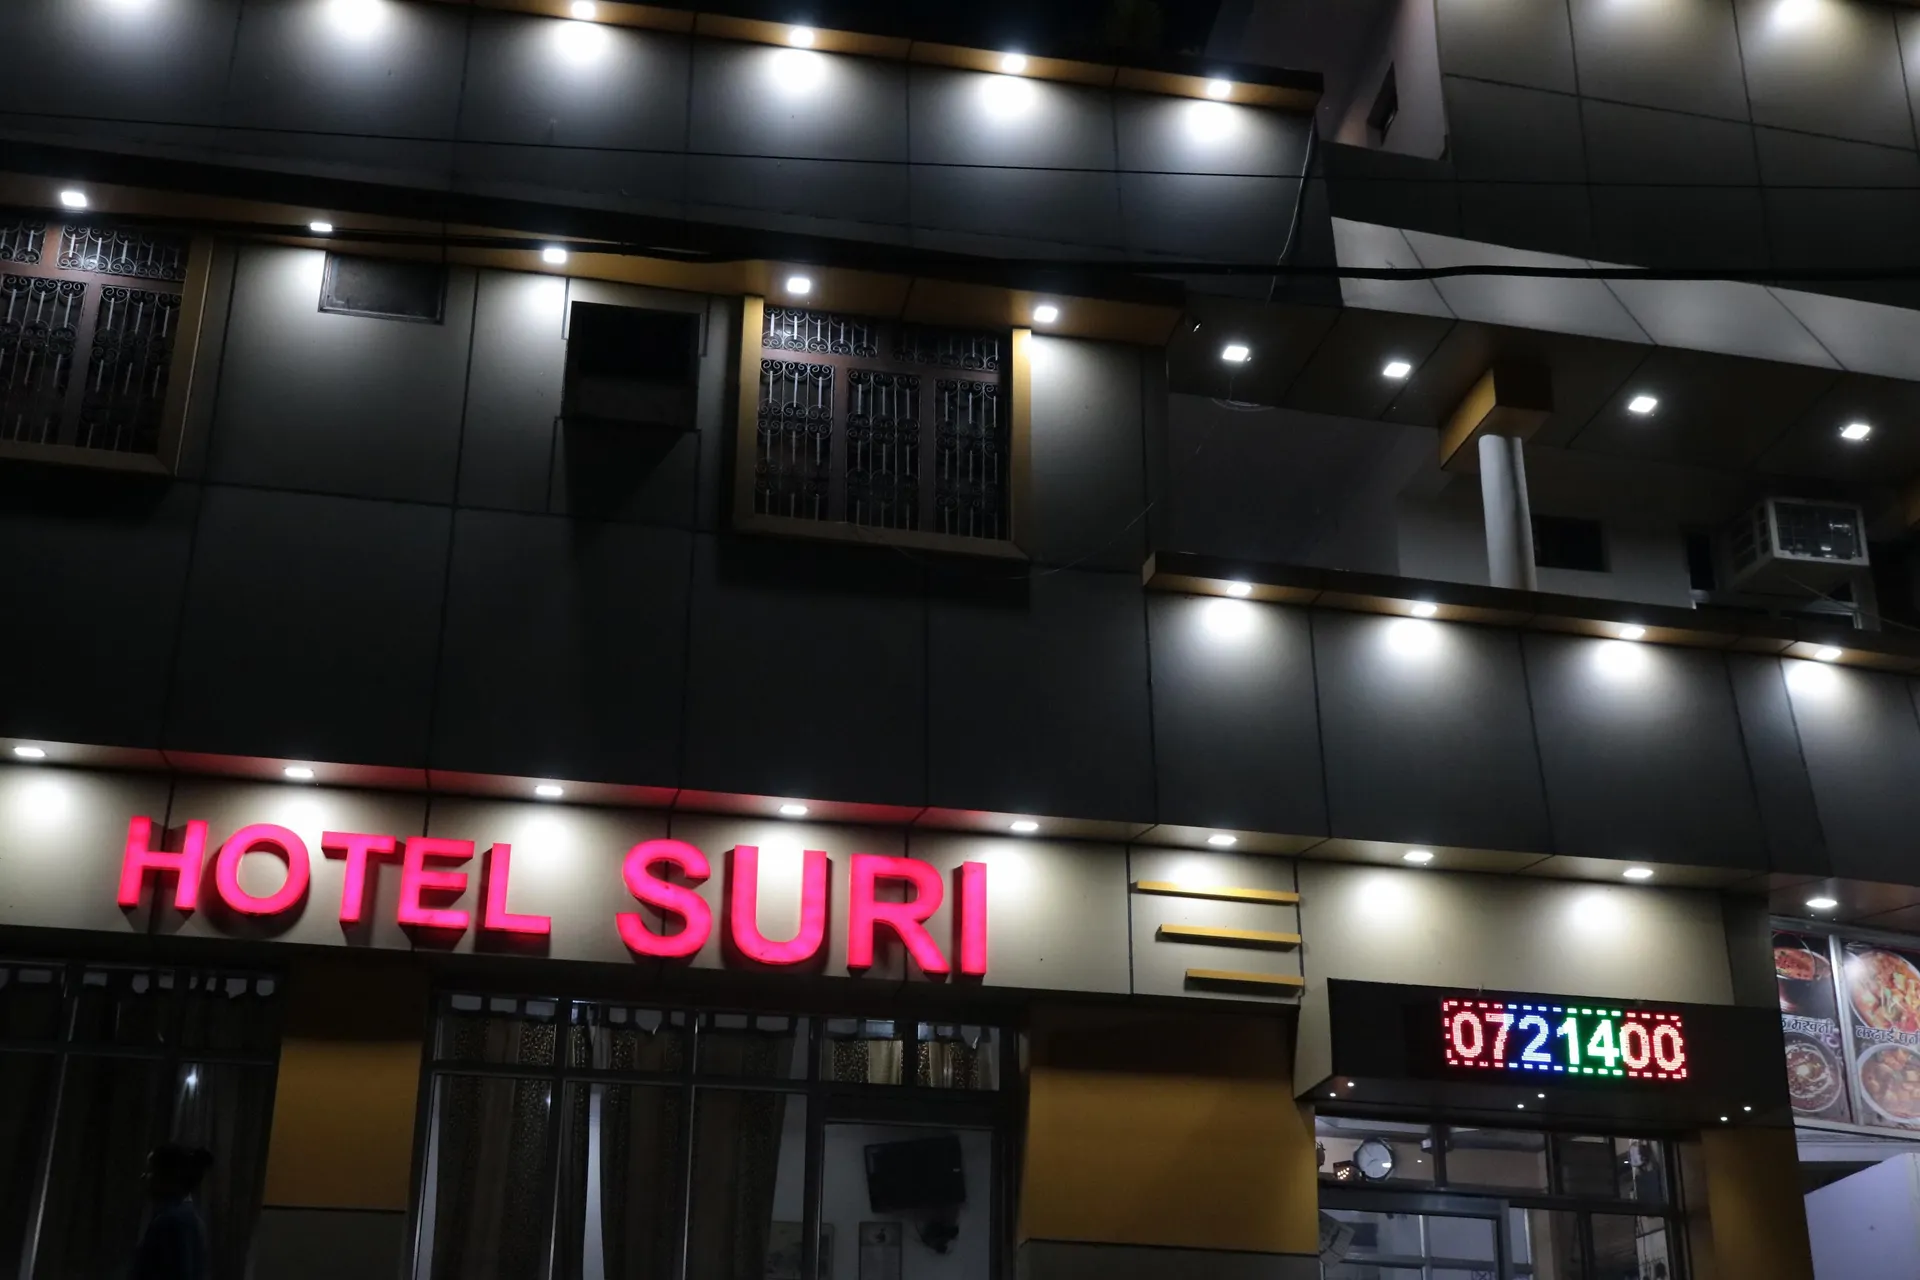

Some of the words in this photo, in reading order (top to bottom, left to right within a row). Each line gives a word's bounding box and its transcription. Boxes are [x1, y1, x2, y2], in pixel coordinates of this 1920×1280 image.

[118, 815, 552, 934] HOTEL
[616, 838, 987, 975] SURI
[1452, 1011, 1686, 1072] 0721400
